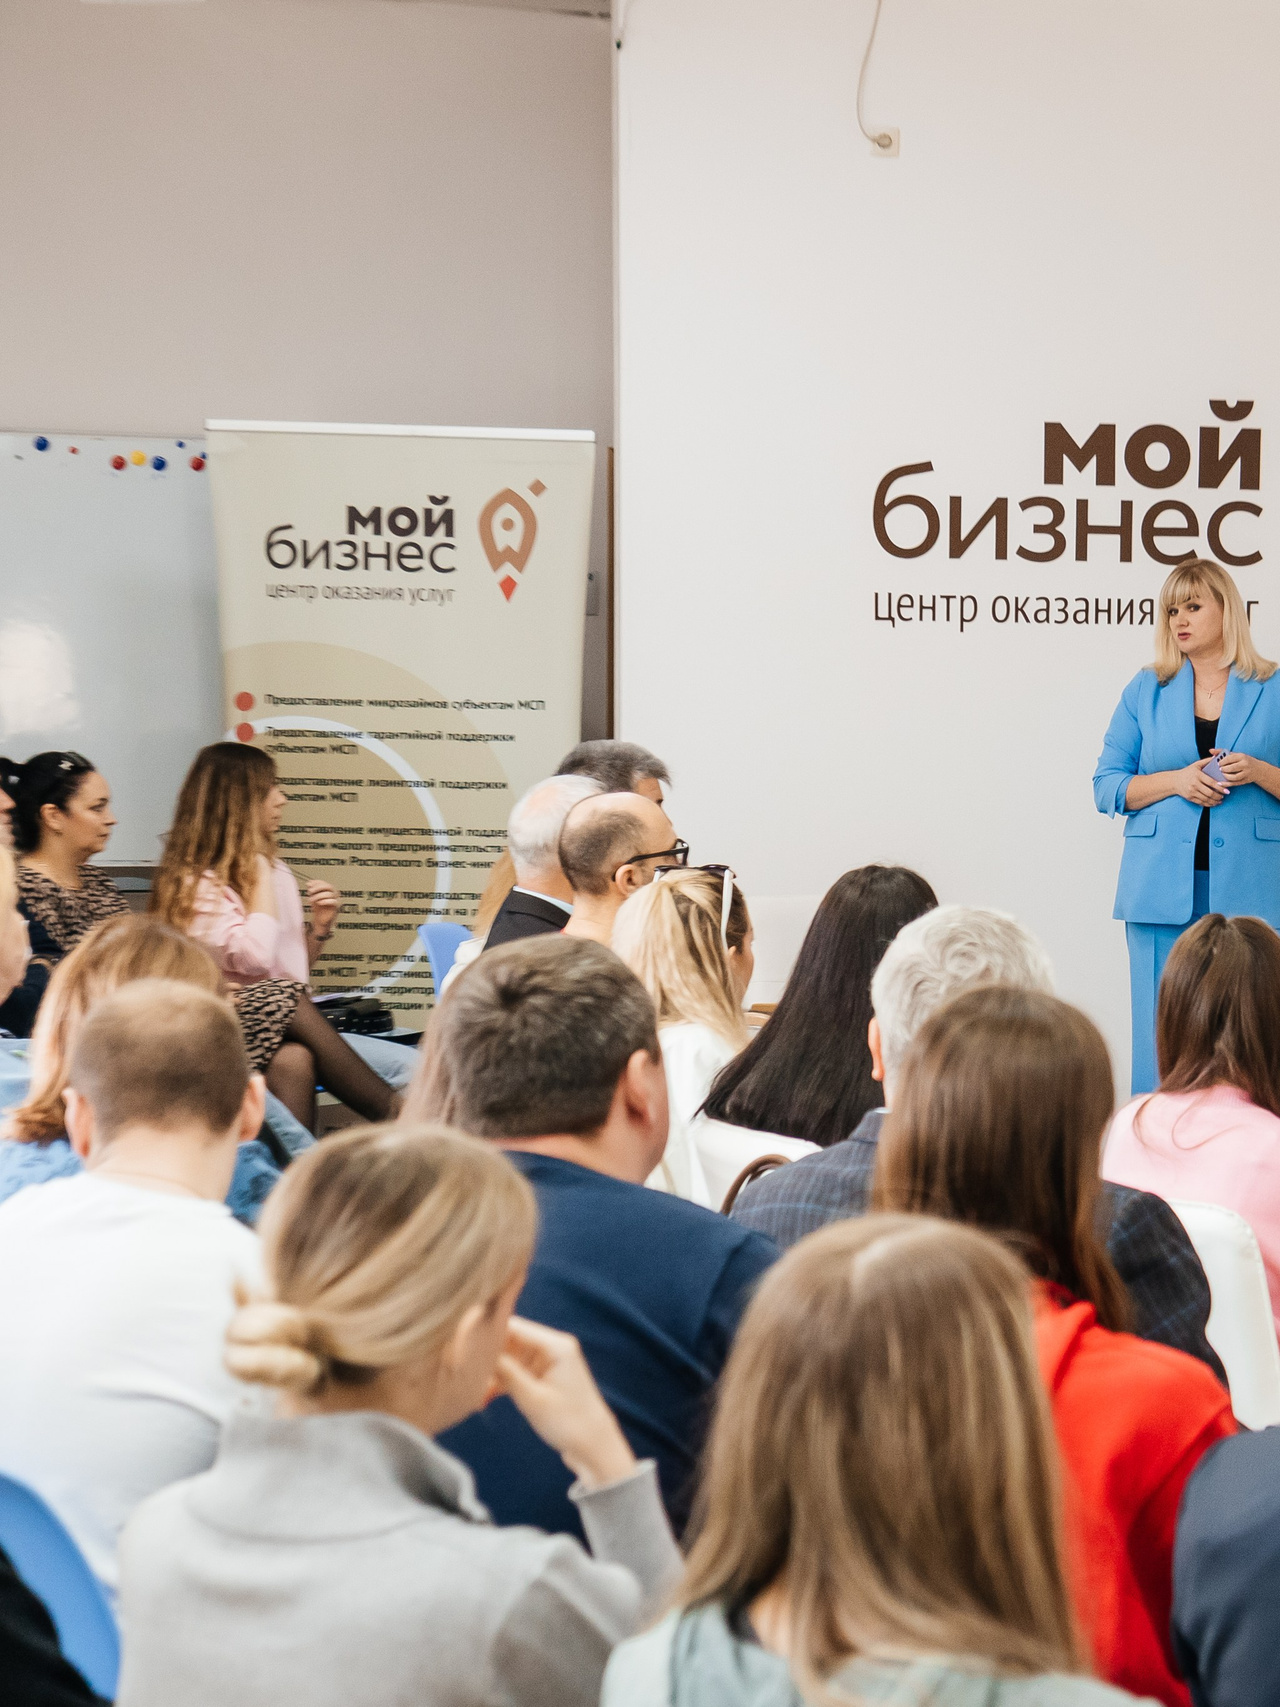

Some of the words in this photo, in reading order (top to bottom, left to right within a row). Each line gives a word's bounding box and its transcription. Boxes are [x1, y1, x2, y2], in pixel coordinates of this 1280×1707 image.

[1043, 399, 1262, 491] мой
[346, 494, 455, 538] мой
[872, 460, 1263, 567] бизнес
[266, 523, 457, 574] бизнес
[265, 583, 318, 604] центр
[321, 585, 405, 601] оказания
[407, 587, 456, 607] услуг
[873, 591, 978, 633] центр
[991, 595, 1155, 626] оказания
[265, 694, 364, 709] Предоставление
[367, 697, 449, 710] микрозаймов
[452, 700, 515, 711] субъектам
[517, 700, 547, 711] МСП
[265, 727, 364, 739] Предоставление
[367, 729, 444, 742] гарантийной
[447, 732, 516, 744] поддержки
[266, 743, 327, 755] субъектам
[329, 744, 359, 756] МСП
[274, 777, 364, 788] редоставление
[367, 777, 436, 789] лизинговой
[440, 780, 508, 791] поддержки
[329, 792, 359, 803] МСП
[280, 825, 364, 836] едоставление
[368, 826, 462, 838] имущественной
[466, 828, 508, 839] поддер
[351, 856, 423, 868] Ростовского
[368, 890, 399, 901] услуг
[366, 906, 451, 917] направленных
[336, 922, 413, 932] инженерных
[367, 954, 399, 964] услуг
[328, 967, 358, 977] МСП
